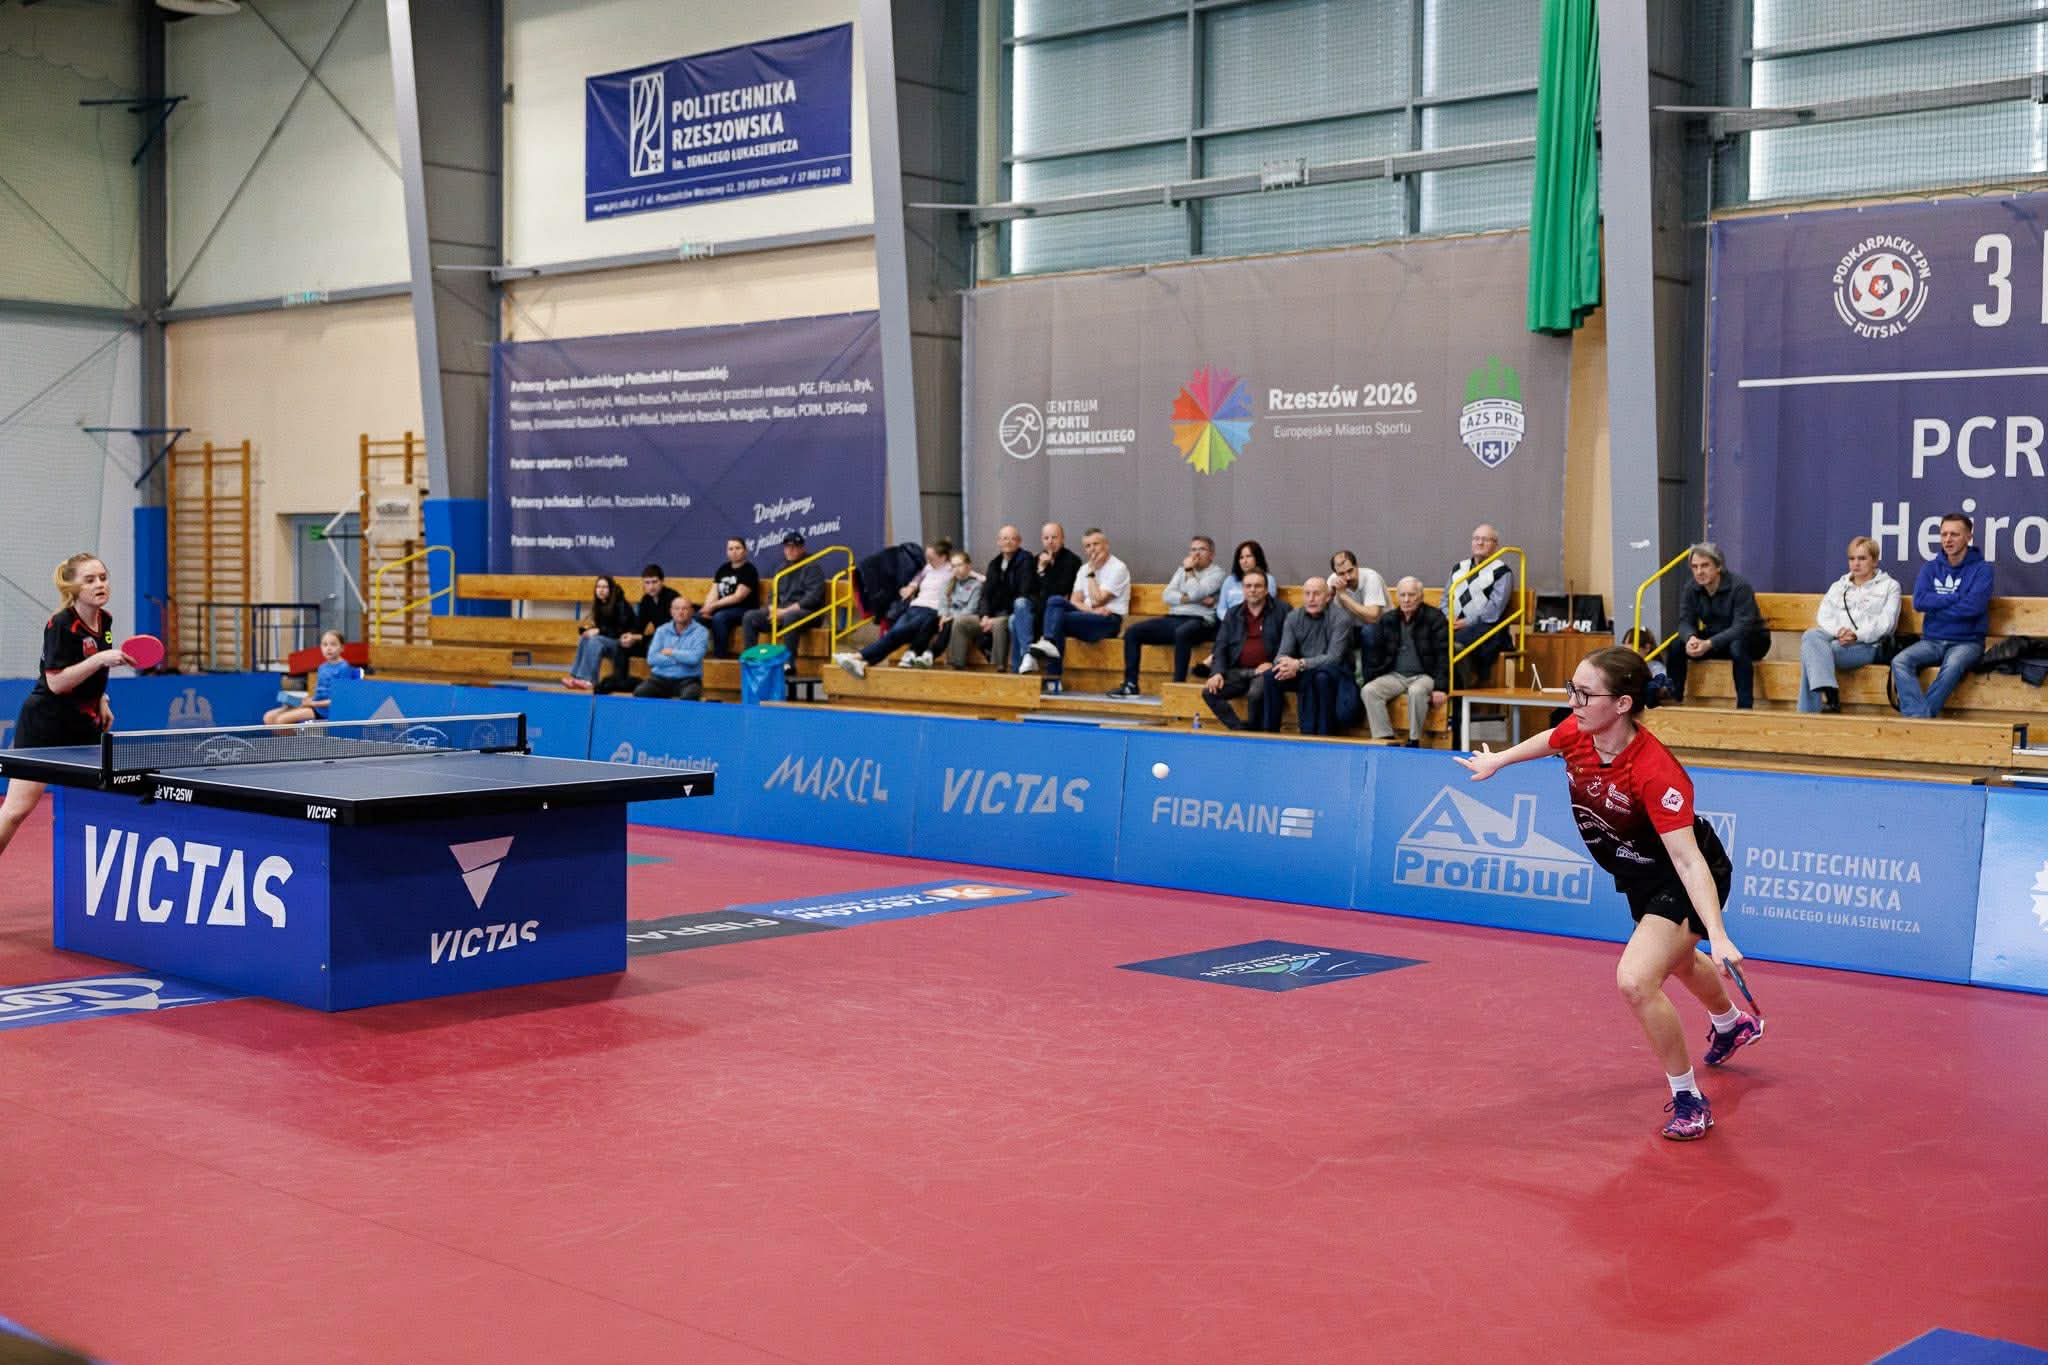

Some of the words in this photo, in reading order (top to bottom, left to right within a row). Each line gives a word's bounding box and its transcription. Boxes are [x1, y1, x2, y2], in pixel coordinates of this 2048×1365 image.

[672, 79, 797, 123] POLITECHNIKA
[672, 111, 785, 151] RZESZOWSKA
[687, 150, 731, 168] IGNACEGO
[732, 139, 799, 161] ŁUKASIEWICZA
[1833, 235, 1915, 285] PODKARPACKI
[1910, 250, 1932, 279] ZPN
[1973, 233, 2012, 327] 3
[1853, 319, 1907, 339] FUTSAL
[1269, 385, 1358, 410] Rzeszów
[1363, 382, 1418, 407] 2026
[1273, 423, 1332, 440] Europejskie
[1335, 422, 1372, 437] Miasto
[1375, 420, 1411, 436] Sportu
[1466, 412, 1490, 429] AZS
[808, 516, 841, 537] nami
[204, 748, 244, 763] PGE
[113, 774, 142, 784] VICTAS
[163, 786, 194, 802] VT-25W
[763, 753, 890, 805] MARCEL
[942, 767, 1092, 814] VICTAS
[306, 804, 337, 819] VICTAS
[1151, 796, 1279, 835] FIBRAIN
[1408, 790, 1532, 849] AJ
[85, 824, 294, 928] VICTAS
[1396, 849, 1590, 901] Profibud
[1745, 847, 1921, 883] POLITECHNIKA
[1743, 875, 1902, 911] RZESZOWSKA
[1763, 905, 1824, 923] IGNACEGO
[1826, 912, 1921, 934] ŁUKASIEWICZA
[431, 919, 540, 964] VICTAS
